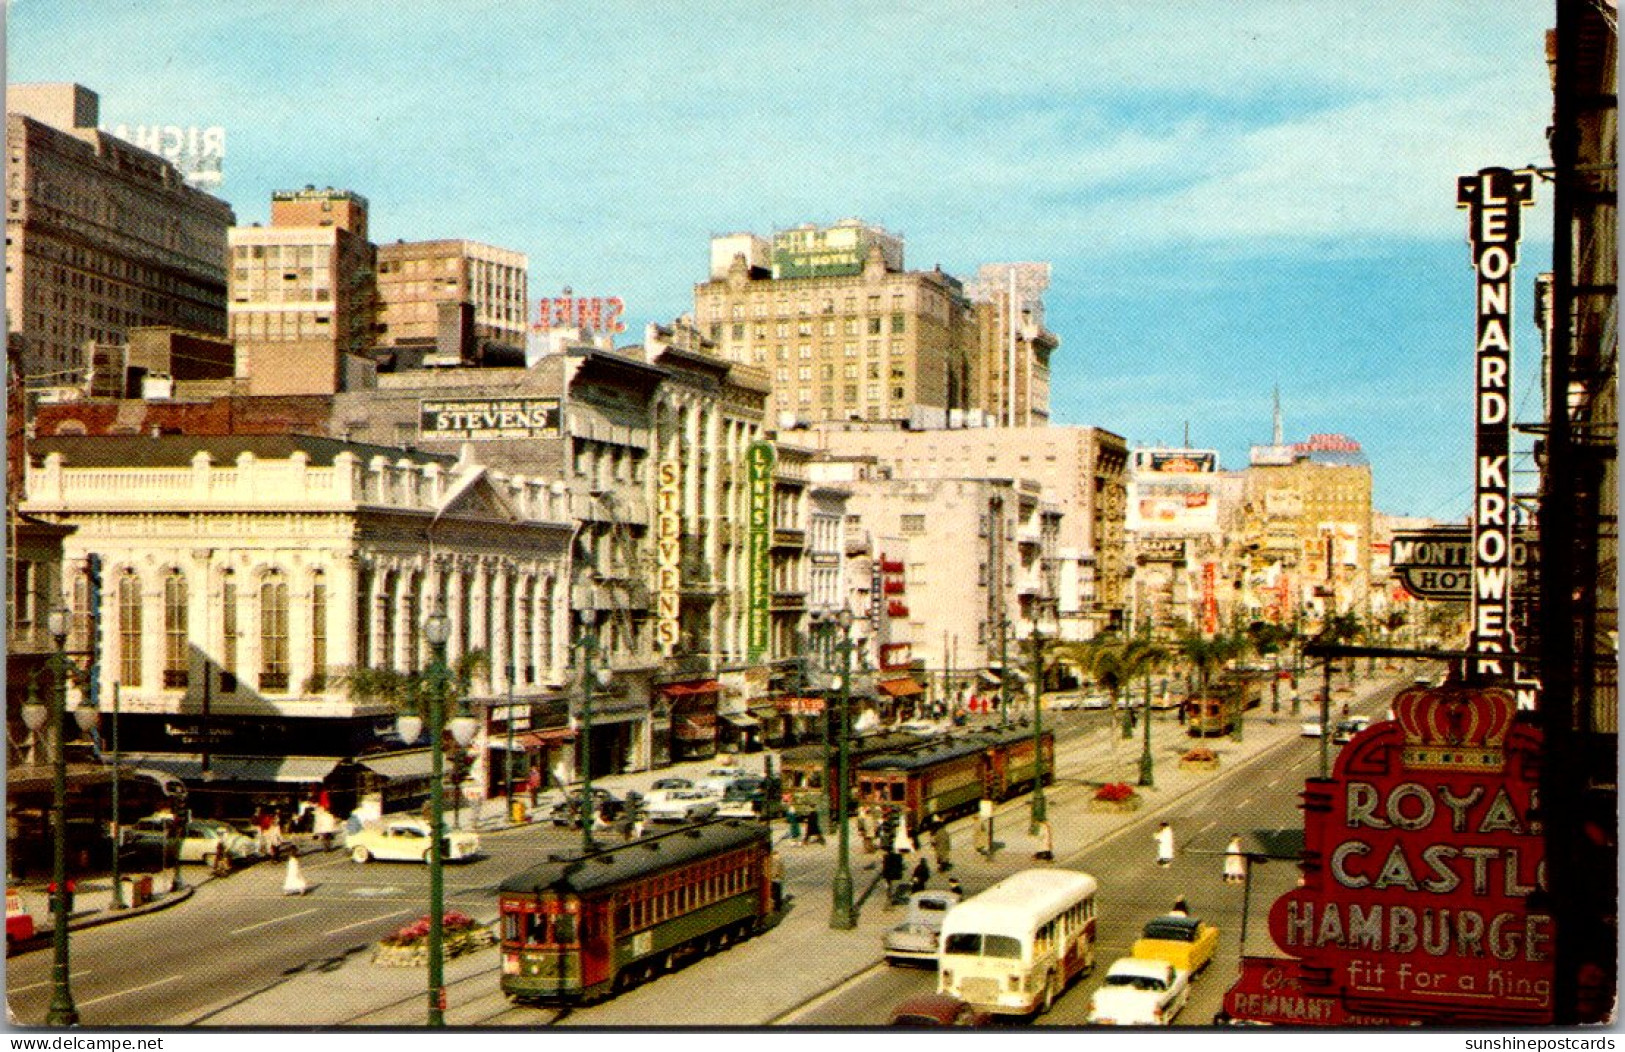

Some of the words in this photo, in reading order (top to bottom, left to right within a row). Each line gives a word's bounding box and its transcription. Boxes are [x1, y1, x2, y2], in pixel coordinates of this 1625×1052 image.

[1479, 174, 1509, 424] LEONARD
[437, 410, 549, 430] STEVENS
[753, 448, 764, 525] LYNNS
[659, 462, 678, 645] STEVENS
[1477, 455, 1508, 674] KROWER
[1234, 992, 1336, 1021] REMNANT
[1347, 960, 1385, 988] fit
[1396, 963, 1447, 991] for
[1457, 974, 1475, 991] a
